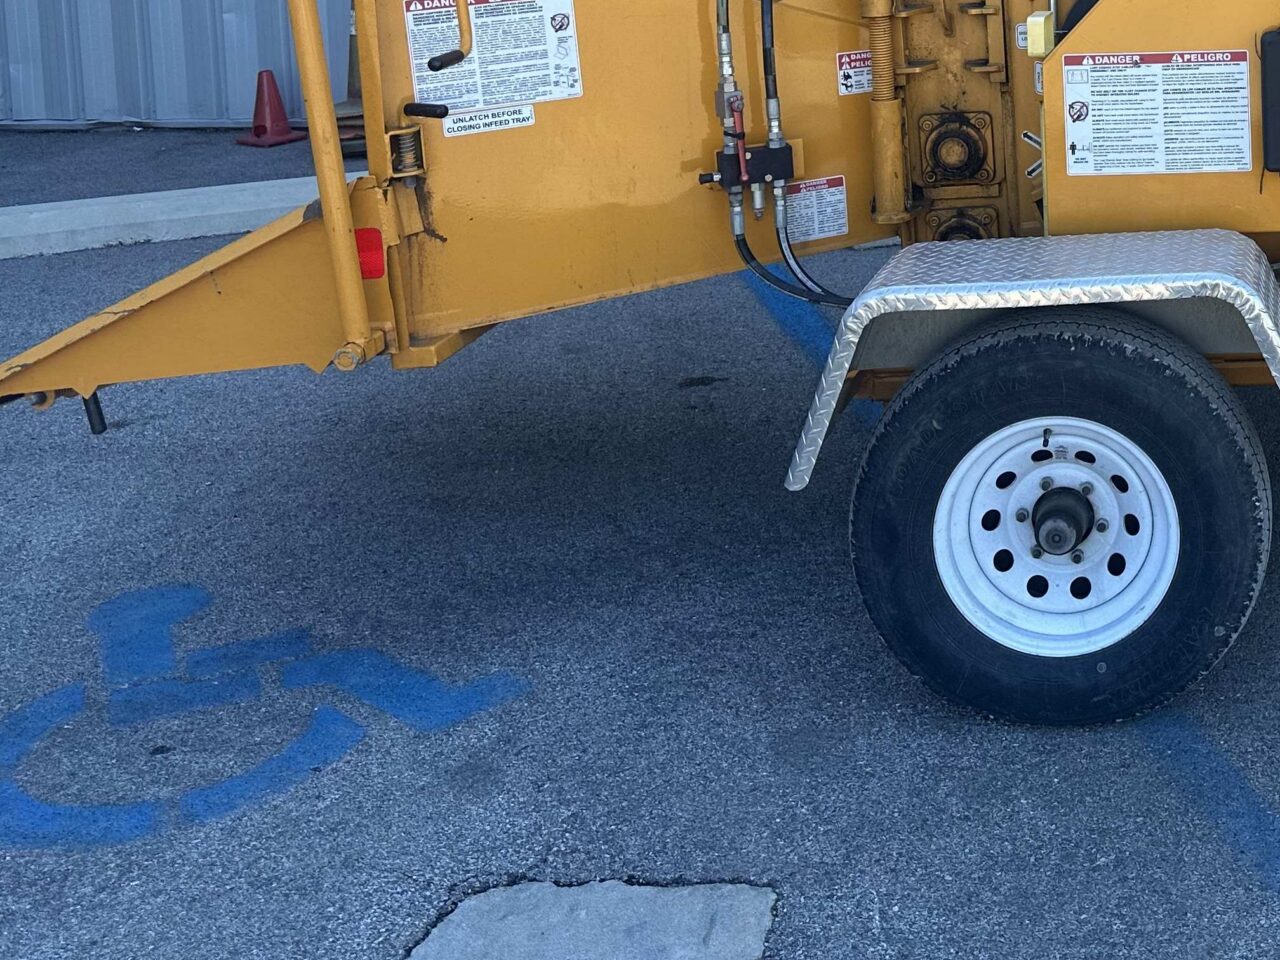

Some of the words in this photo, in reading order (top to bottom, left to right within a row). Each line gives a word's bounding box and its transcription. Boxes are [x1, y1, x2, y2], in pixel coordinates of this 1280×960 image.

[850, 52, 872, 60] DANG
[1095, 55, 1140, 64] DANGER
[1184, 53, 1231, 62] PELIGRO
[851, 60, 872, 68] PELIG
[452, 114, 490, 124] UNLATCH
[491, 109, 523, 119] BEFORE
[447, 123, 481, 134] CLOSING
[483, 119, 510, 128] INFEED
[511, 115, 531, 124] TRAY
